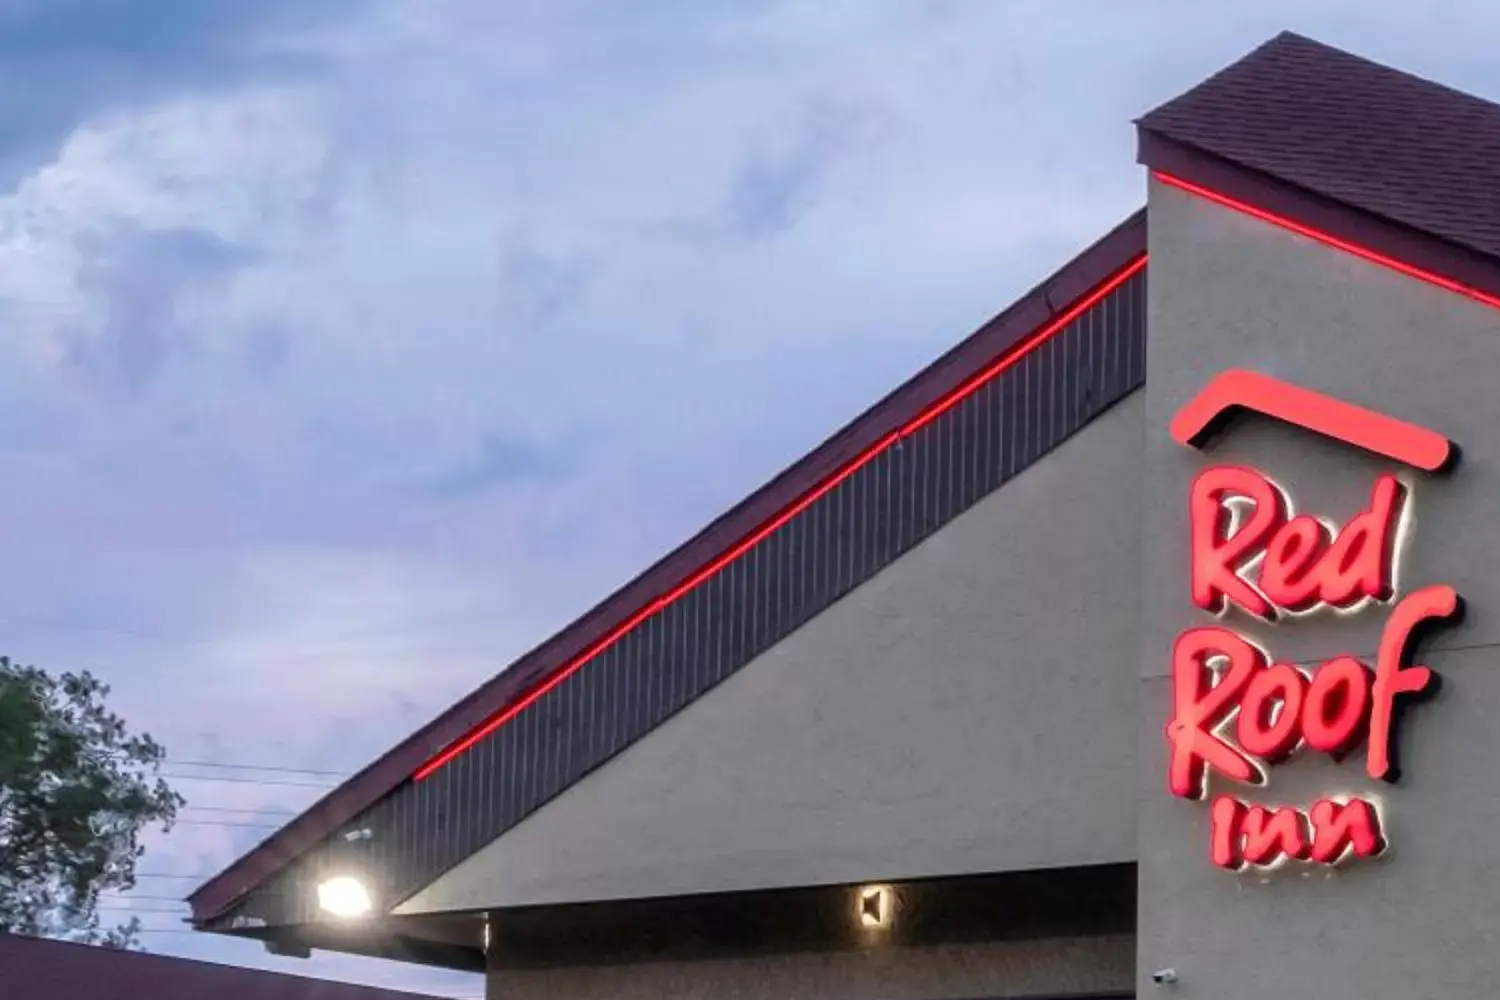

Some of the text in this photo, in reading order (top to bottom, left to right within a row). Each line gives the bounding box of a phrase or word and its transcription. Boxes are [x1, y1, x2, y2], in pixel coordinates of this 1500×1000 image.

[1190, 465, 1404, 617] Red
[1166, 584, 1462, 798] Roof
[1210, 795, 1384, 868] Inn
